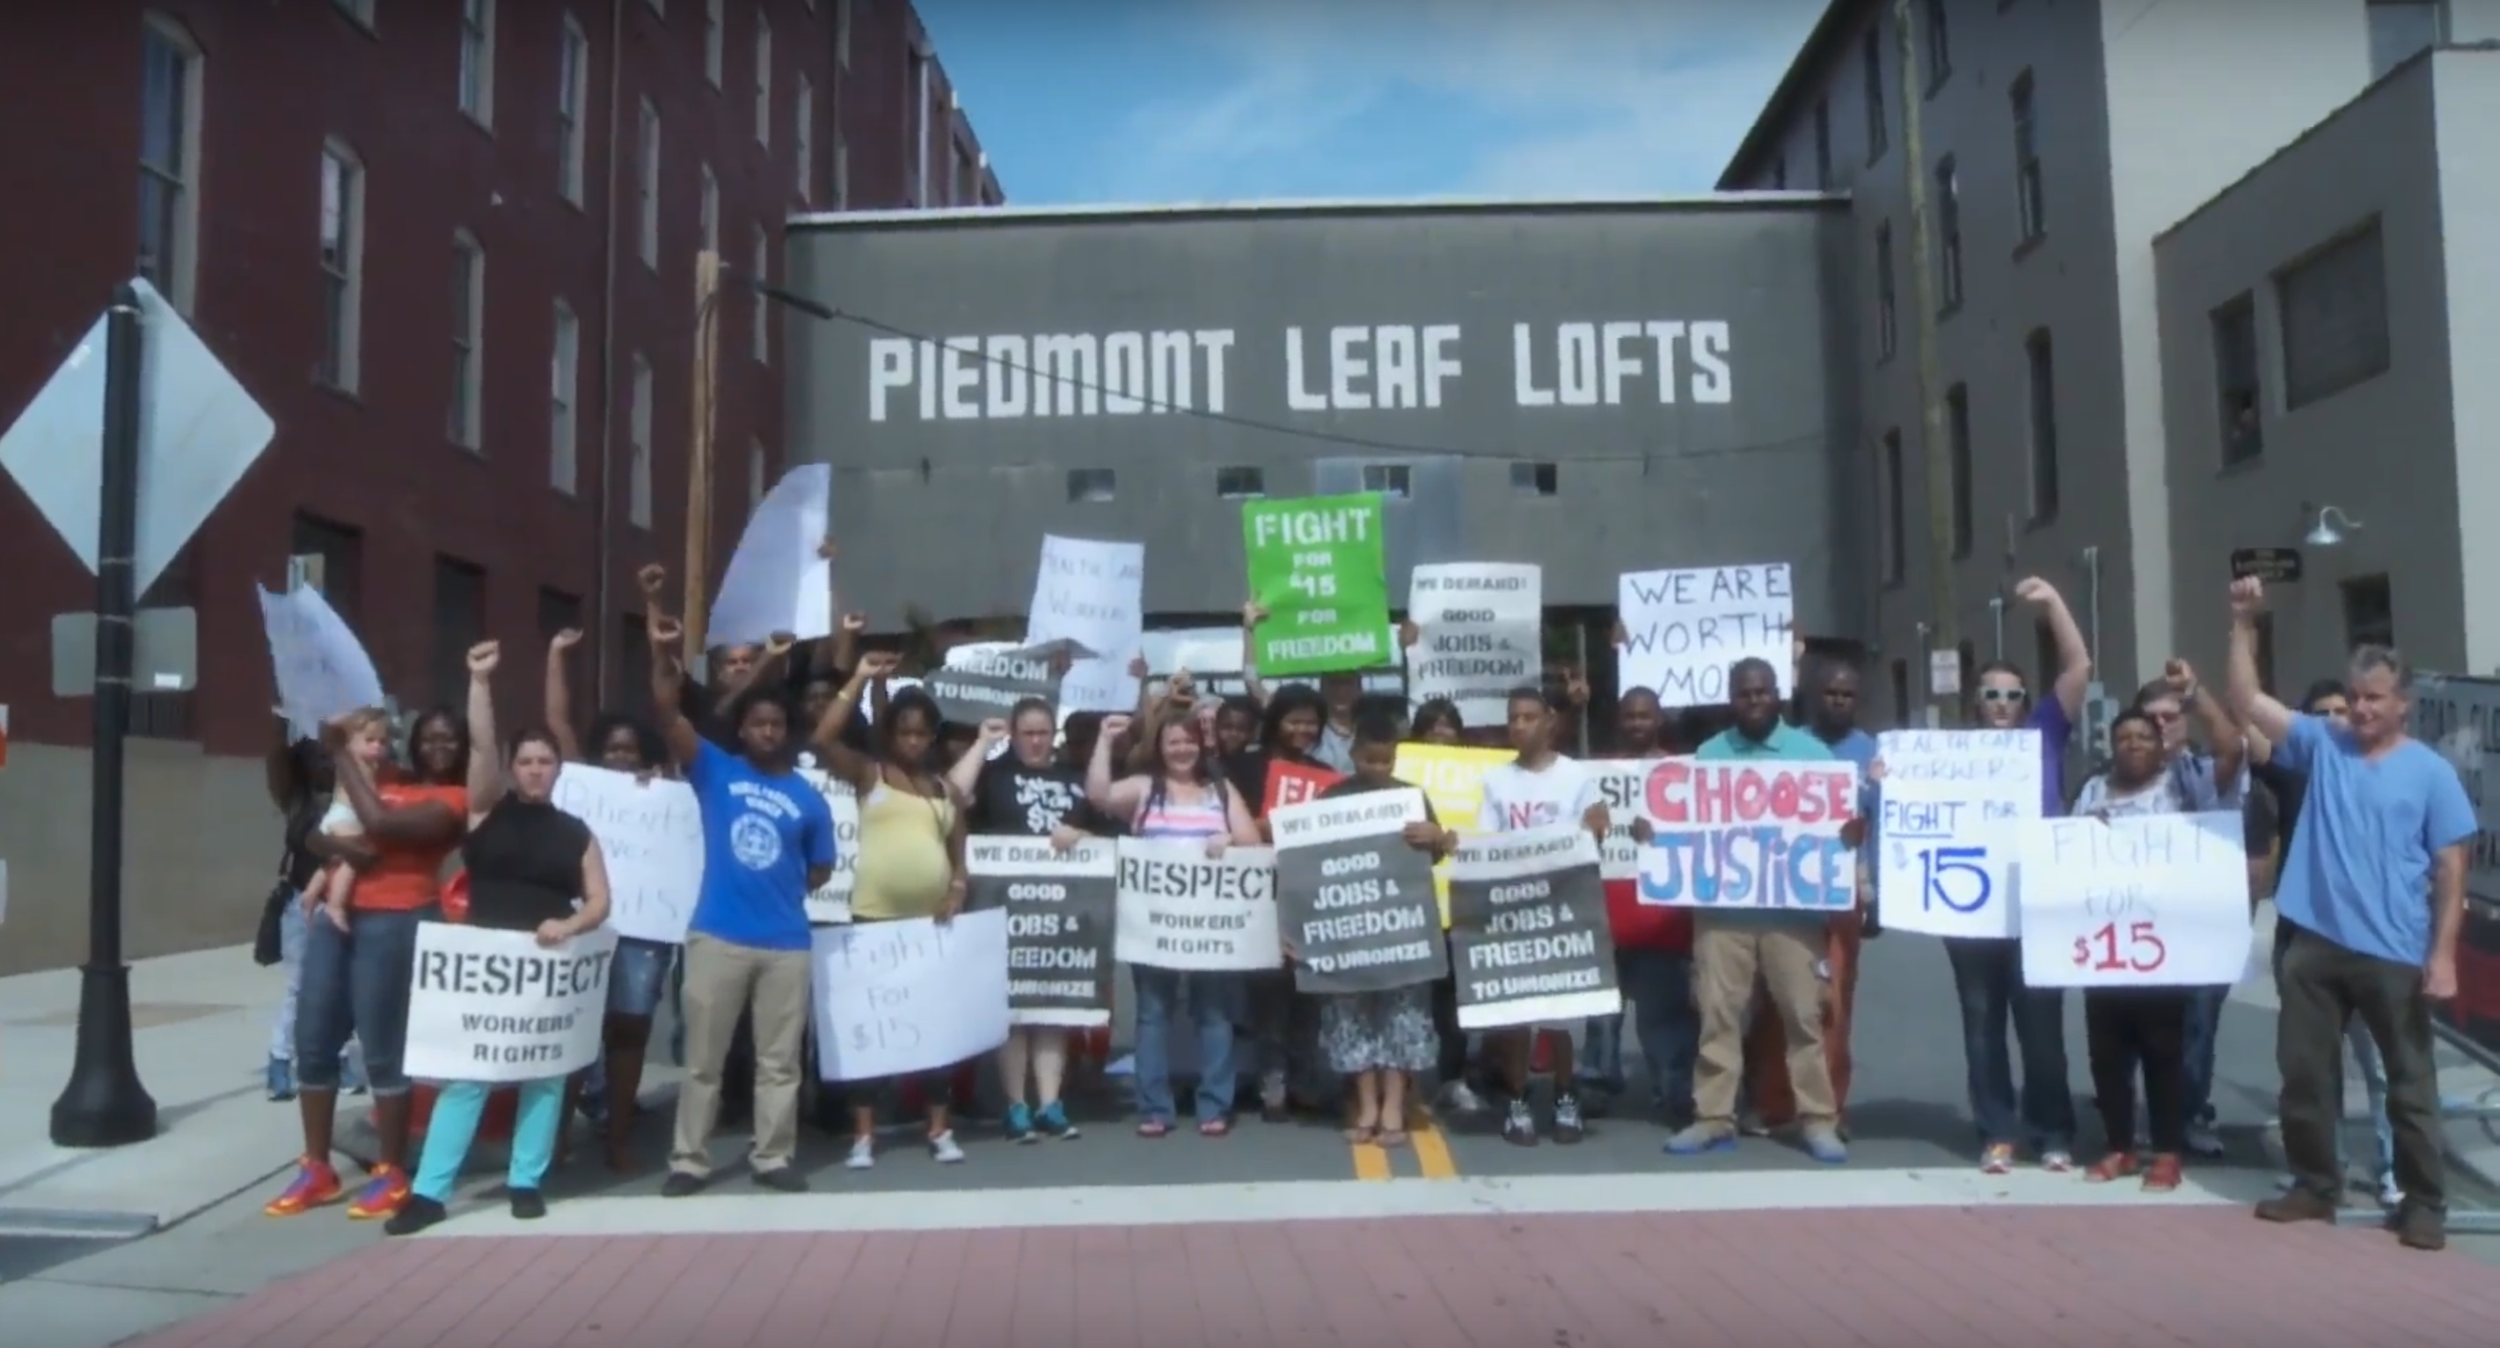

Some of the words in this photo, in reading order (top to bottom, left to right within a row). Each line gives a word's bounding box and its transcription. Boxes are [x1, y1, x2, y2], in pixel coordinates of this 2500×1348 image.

[869, 329, 1235, 421] PIEDMONT
[1286, 324, 1462, 411] LEAF
[1513, 320, 1732, 405] LOFTS
[1255, 507, 1371, 547] FIGHT
[1293, 552, 1332, 568] FOR
[1630, 572, 1696, 605] WE
[1710, 563, 1790, 603] ARE
[1297, 608, 1337, 625] FOR
[1441, 609, 1496, 623] GOOD
[1267, 631, 1377, 662] FREEDOM
[1433, 632, 1493, 653] JOBS
[1624, 612, 1787, 656] WORTH
[1417, 657, 1525, 680] FREEDOM
[1657, 665, 1723, 702] MO
[1645, 762, 1854, 823] CHOOSE
[1282, 817, 1312, 836] WE
[1884, 799, 1967, 832] FIGHT
[973, 847, 1002, 862] WE
[1457, 851, 1482, 863] WE
[2050, 818, 2204, 870] FIGHT
[1320, 852, 1381, 877] GOOD
[1007, 883, 1066, 901] GOOD
[1313, 878, 1382, 911] JOBS
[1489, 880, 1552, 904] GOOD
[1007, 914, 1060, 936] OBS
[1303, 905, 1426, 946] FREEDOM
[1484, 903, 1555, 934] JOBS
[1007, 946, 1098, 970] EEDOM
[1156, 938, 1235, 955] RIGHTS
[1307, 954, 1336, 974] TO
[1339, 940, 1432, 970] UNIONIZE
[1468, 930, 1596, 971] FREEDOM
[2073, 922, 2166, 972] $15
[418, 949, 612, 998] RESPECT
[1470, 980, 1500, 1001] TO
[1503, 966, 1602, 995] UNIONIZE
[473, 1044, 563, 1063] RIGHTS
